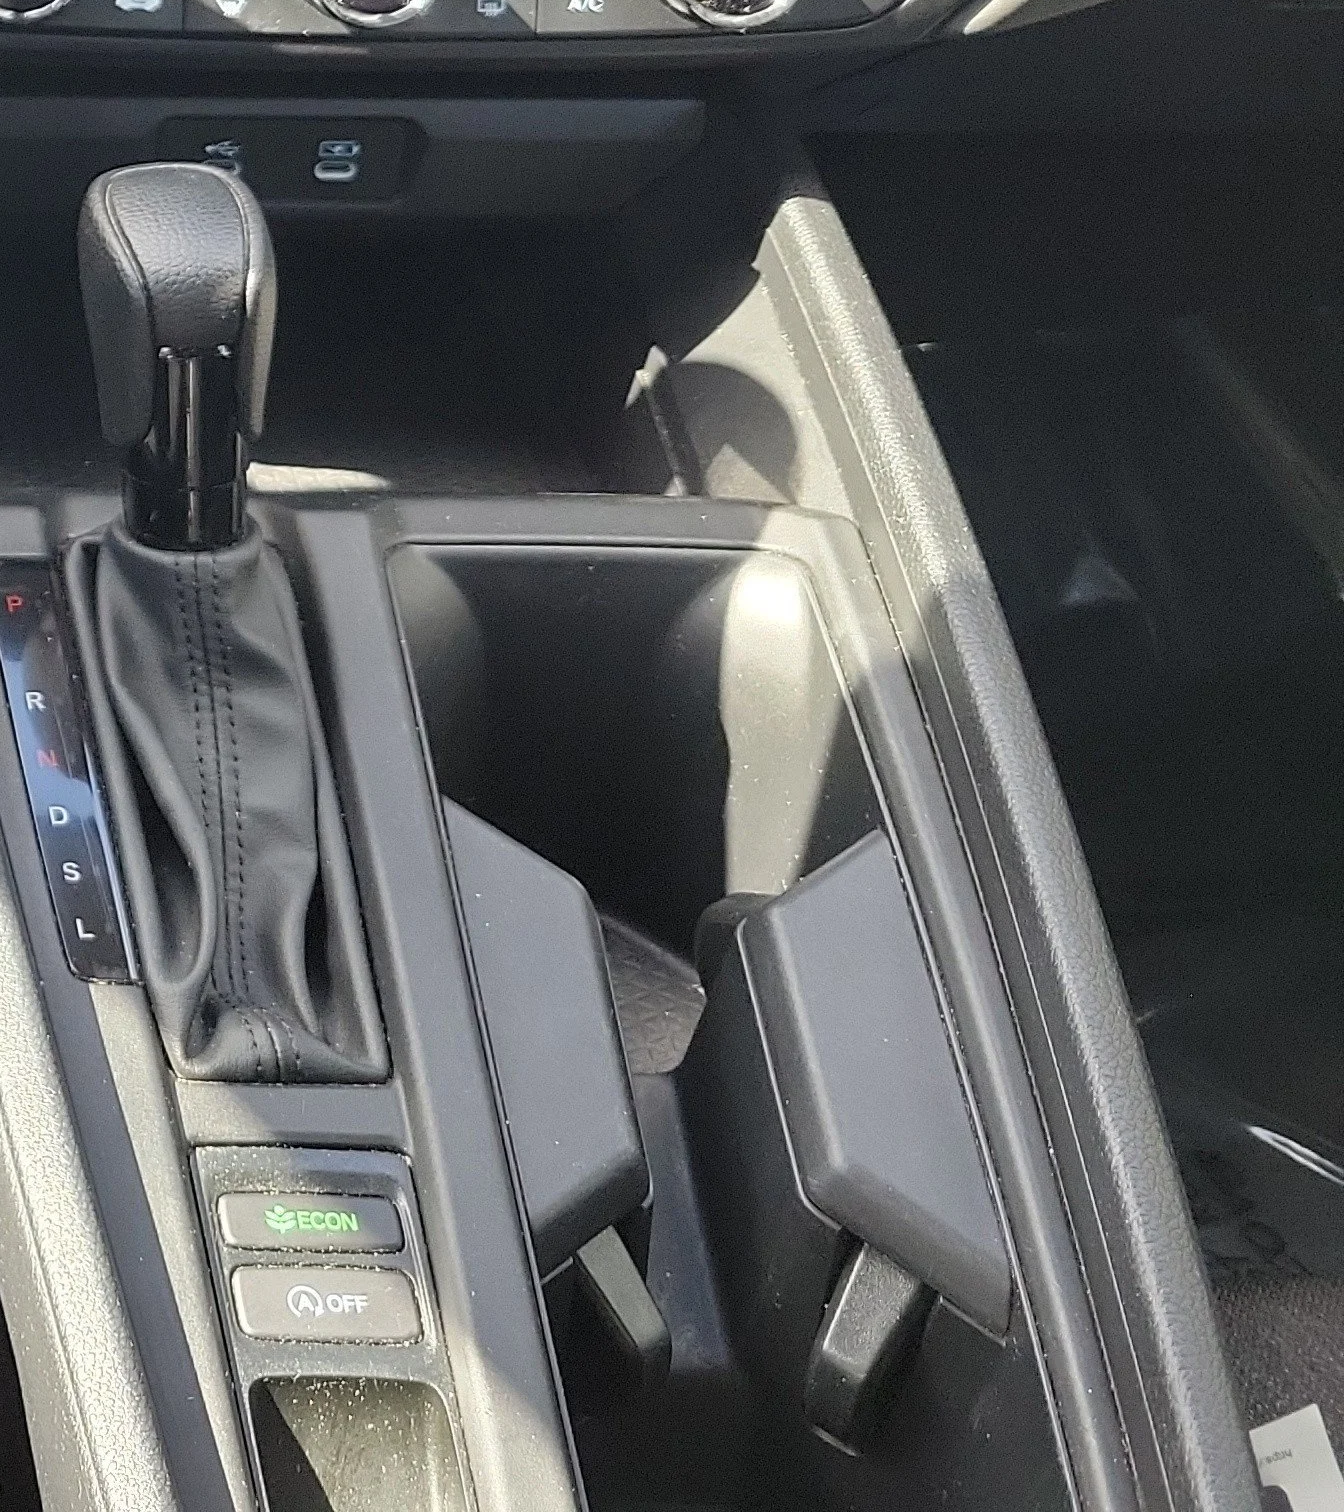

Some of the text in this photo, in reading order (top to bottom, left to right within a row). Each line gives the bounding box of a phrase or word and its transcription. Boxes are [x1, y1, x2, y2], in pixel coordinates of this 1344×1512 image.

[5, 594, 25, 612] P
[24, 691, 46, 712] R
[35, 749, 59, 767] N
[48, 805, 69, 825] D
[62, 862, 82, 882] S
[75, 917, 95, 940] L
[296, 1209, 359, 1232] ECON
[326, 1293, 369, 1314] OFF
